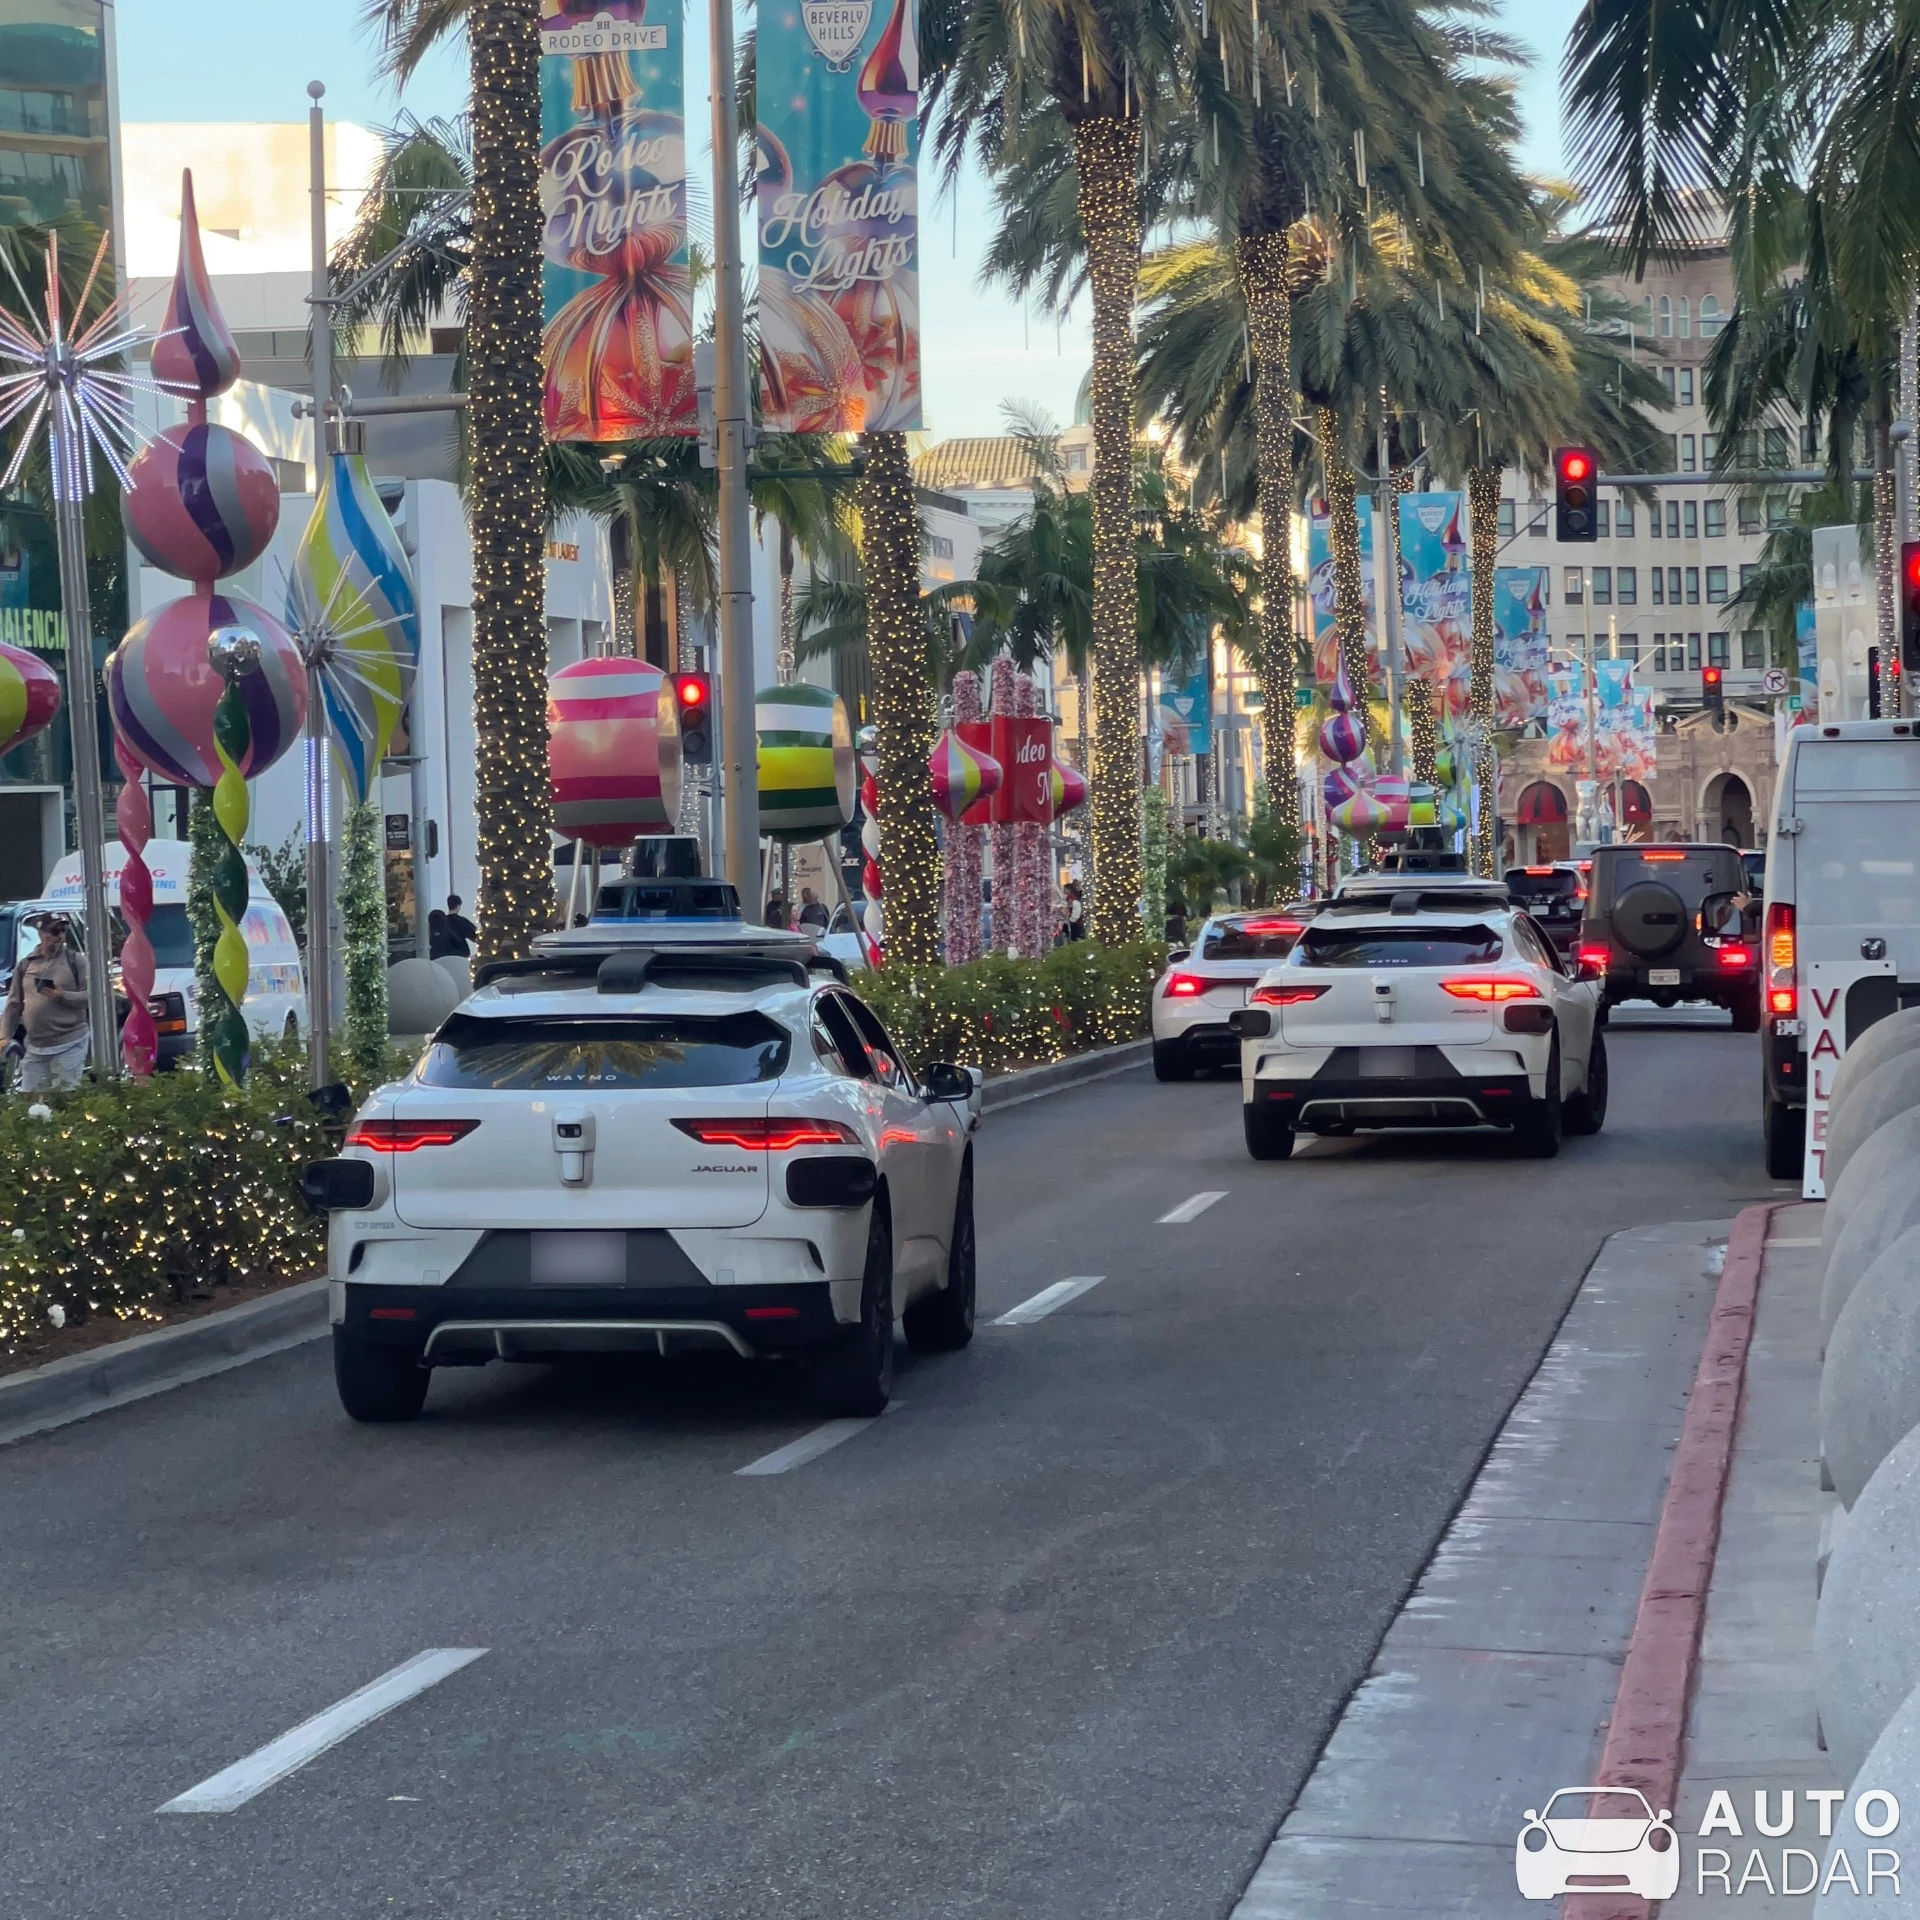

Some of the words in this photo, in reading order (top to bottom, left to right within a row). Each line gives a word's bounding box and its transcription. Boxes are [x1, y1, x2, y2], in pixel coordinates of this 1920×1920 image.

[597, 21, 610, 30] BH
[811, 11, 863, 24] BEVERLY
[549, 34, 603, 49] RODEO
[612, 30, 659, 46] DRIVE
[820, 26, 854, 40] HILLS
[551, 132, 667, 197] Rodeo
[542, 184, 680, 255] Nights
[761, 184, 909, 248] Holiday
[787, 233, 915, 293] Lights
[1415, 600, 1467, 622] Lights
[691, 1165, 758, 1173] JAGUAR
